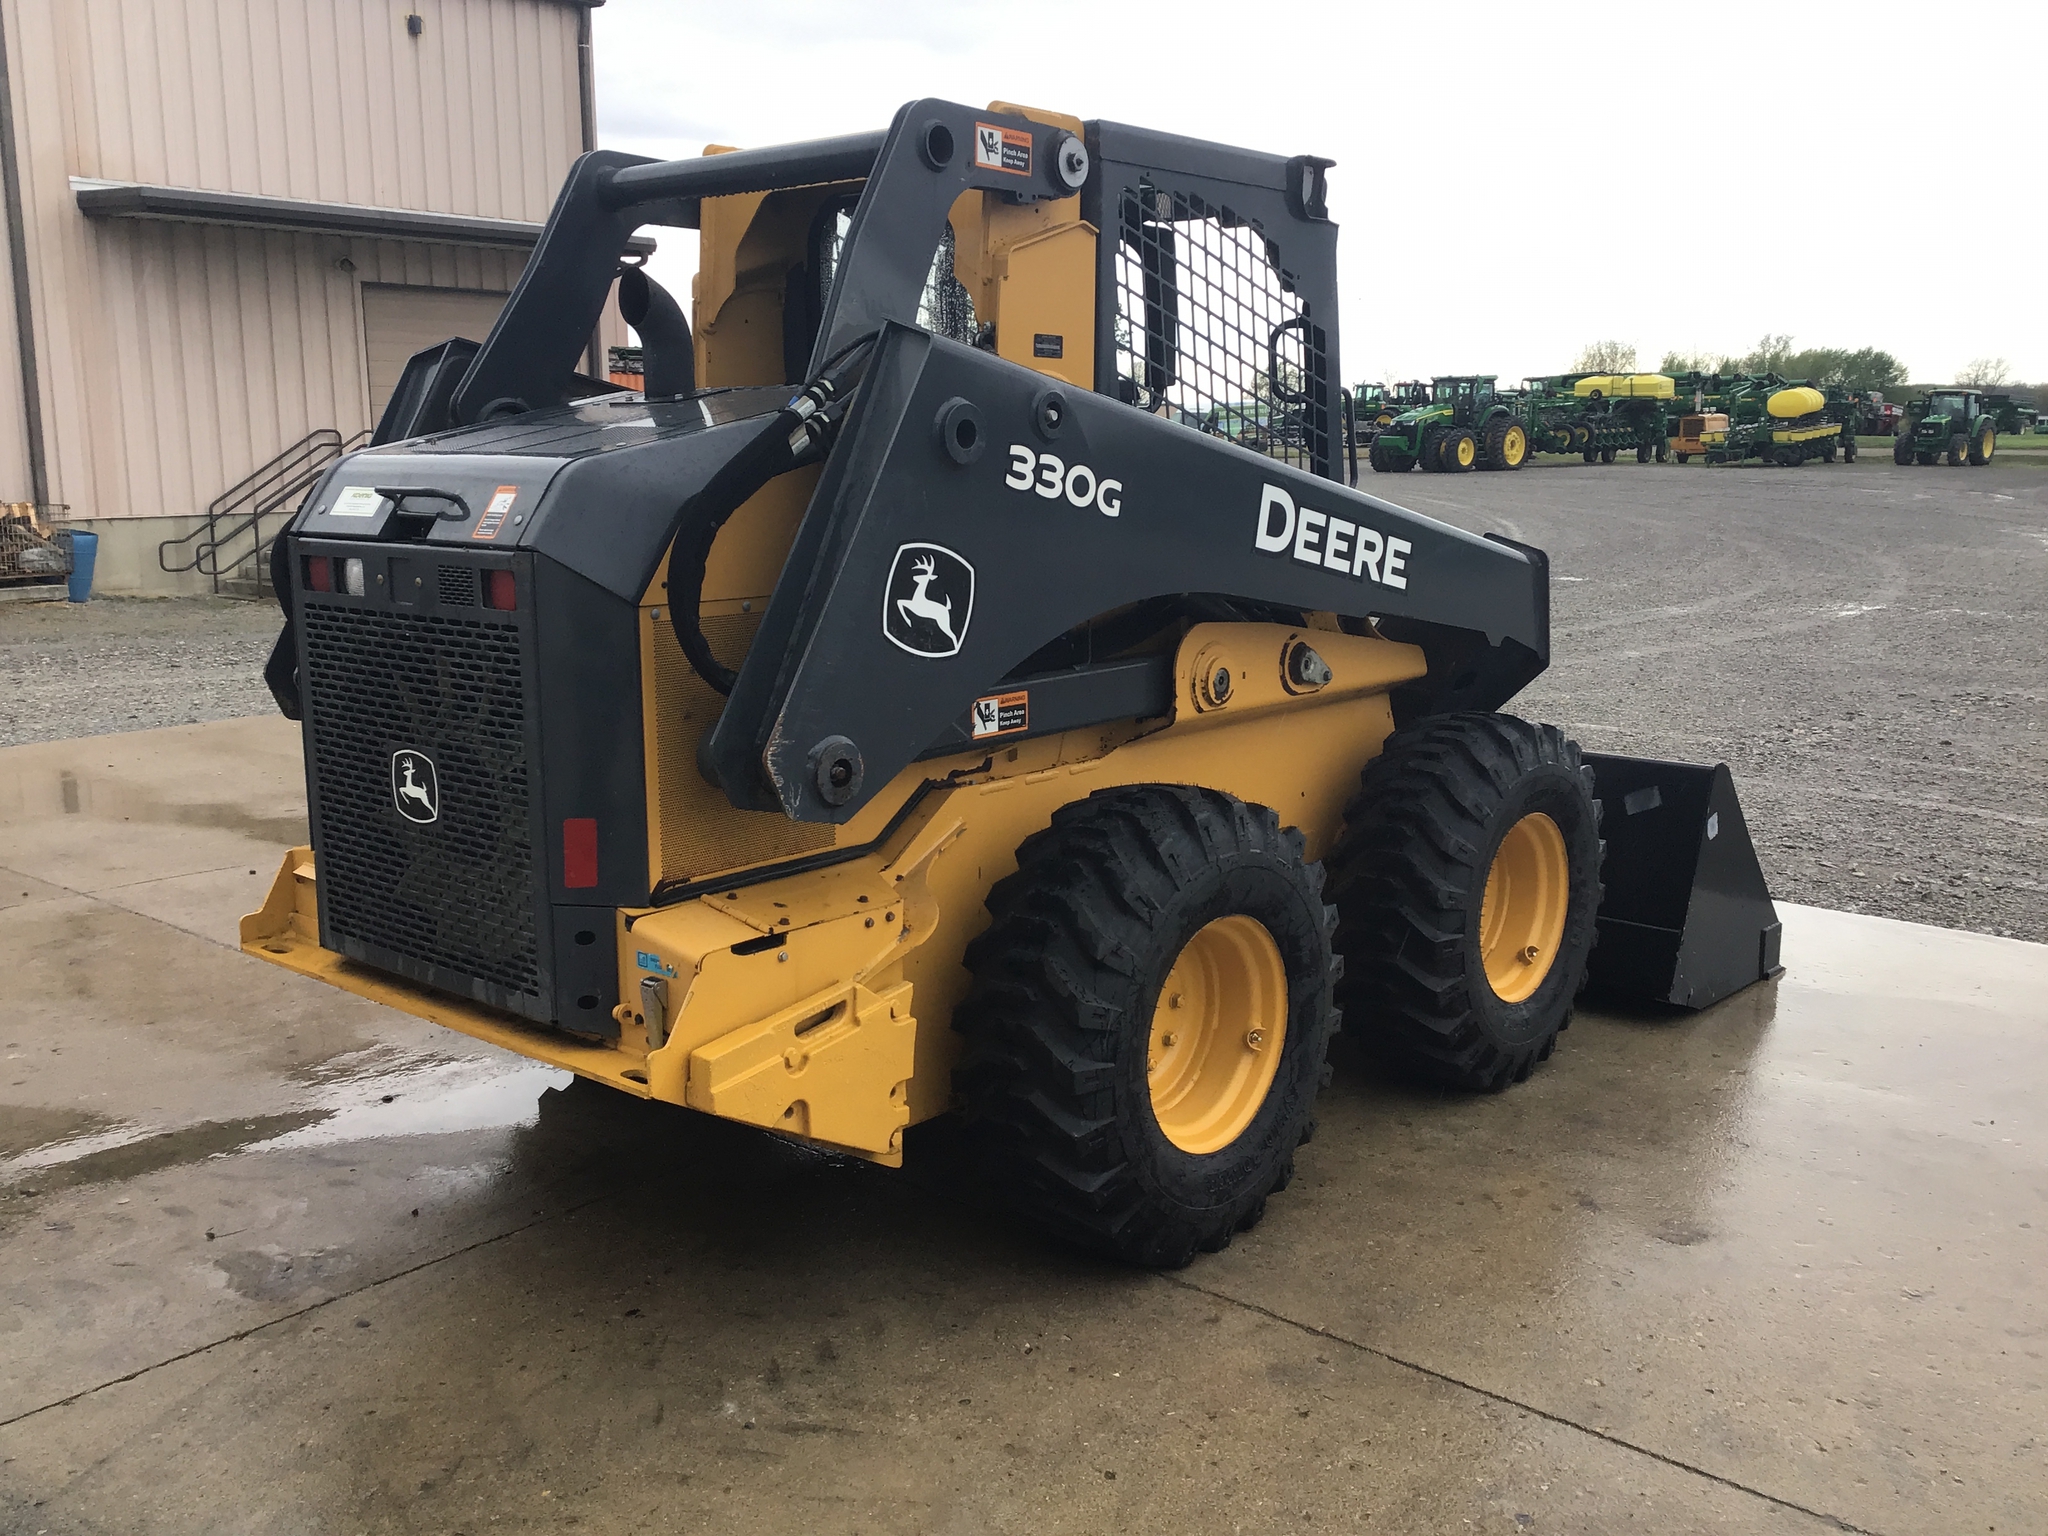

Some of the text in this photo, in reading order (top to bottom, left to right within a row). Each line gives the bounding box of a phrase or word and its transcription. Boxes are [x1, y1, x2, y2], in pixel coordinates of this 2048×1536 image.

[1003, 147, 1029, 159] Pinch Area
[1003, 156, 1025, 168] Keep Away
[1005, 444, 1123, 518] 330G
[1255, 482, 1412, 590] DEERE
[1005, 695, 1026, 704] WARNING
[999, 711, 1013, 719] Pinch
